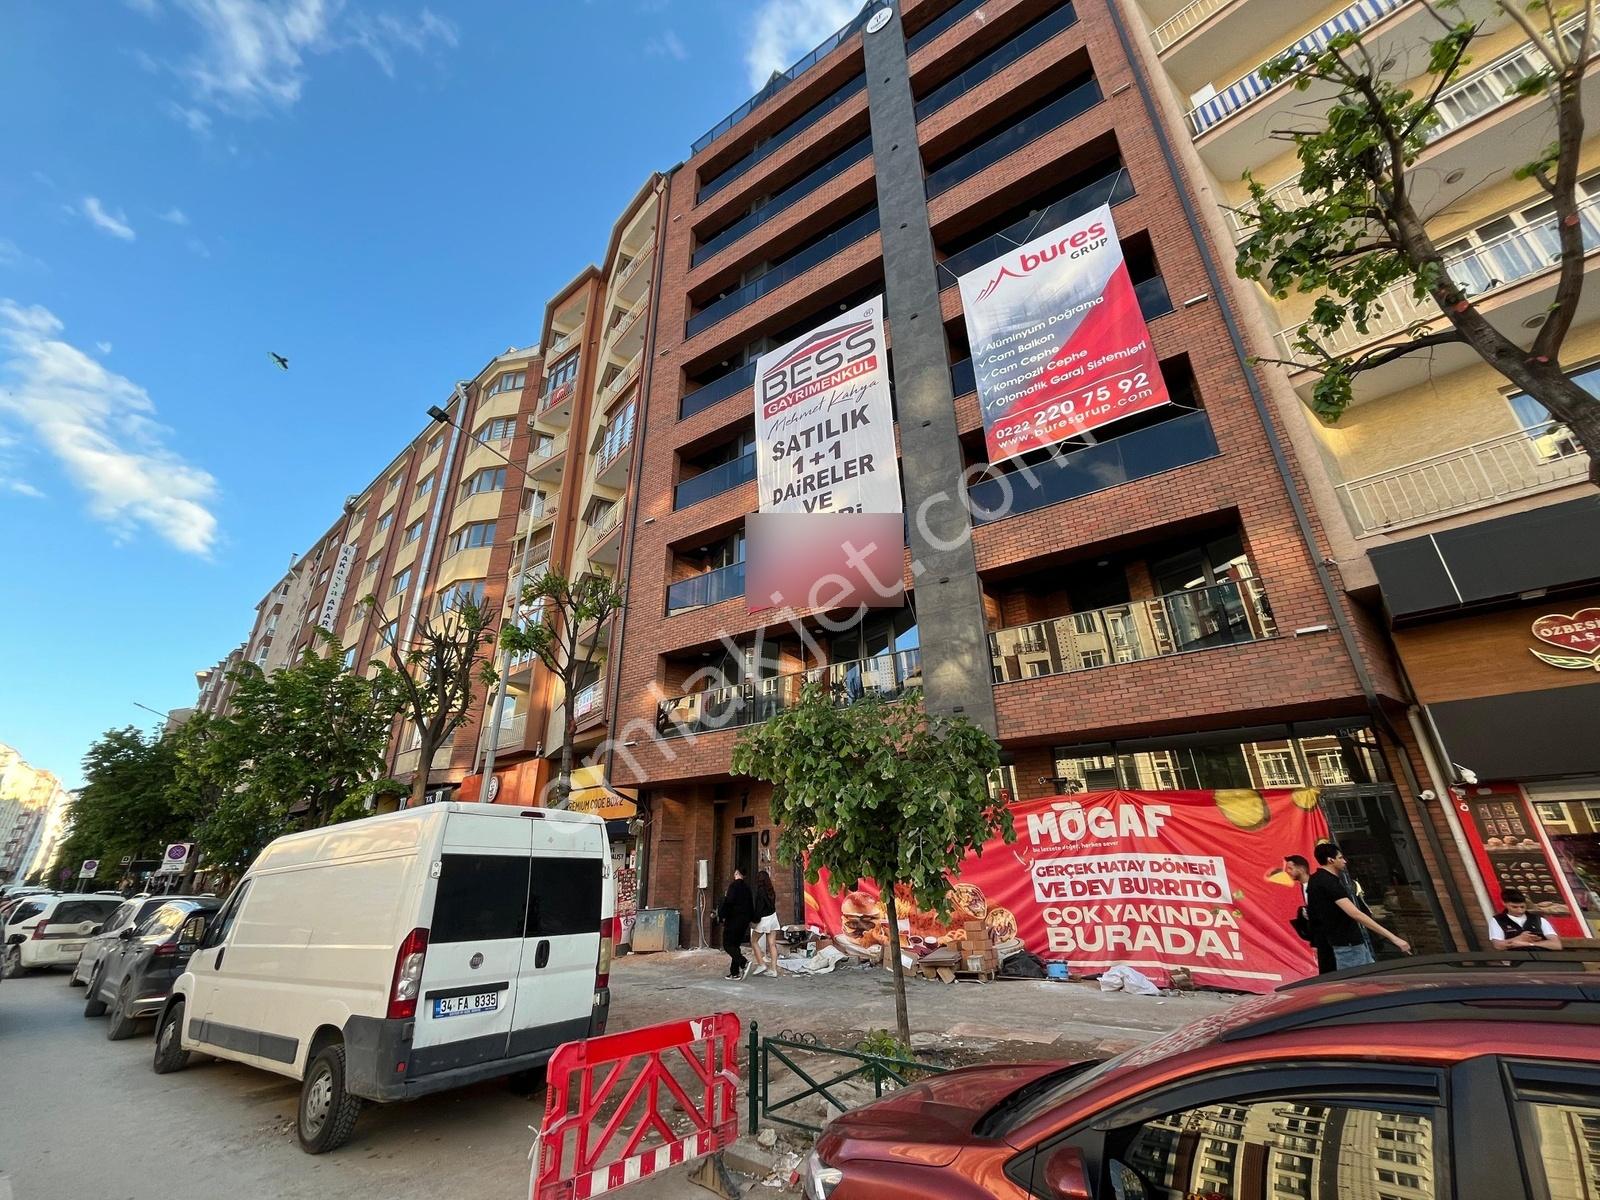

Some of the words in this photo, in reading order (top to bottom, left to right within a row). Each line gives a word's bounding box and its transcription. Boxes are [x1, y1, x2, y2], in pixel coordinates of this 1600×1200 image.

[1020, 222, 1105, 272] bures
[1070, 237, 1108, 260] GRUP
[1048, 296, 1104, 325] Doğrama
[988, 349, 1016, 363] Cam
[1018, 333, 1055, 353] Balkon
[991, 363, 1018, 378] Cam
[1020, 346, 1060, 367] Cephe
[762, 325, 876, 405] BESS
[993, 367, 1044, 393] Kompozit
[1047, 349, 1088, 371] Cephe
[996, 381, 1047, 406] Otomatik
[1050, 364, 1085, 385] Garaj
[1087, 340, 1147, 370] Sistemleri
[996, 421, 1030, 439] 0222
[1034, 400, 1075, 427] 220
[1082, 386, 1111, 407] 75
[1118, 372, 1150, 394] 92
[998, 388, 1153, 449] www.buresgrup.com
[772, 403, 871, 462] SATILIK
[802, 491, 833, 513] VE
[1036, 860, 1097, 879] GERÇEK
[1097, 859, 1146, 873] HATAY
[1150, 858, 1217, 876] DÖNERİ
[1038, 881, 1067, 898] VE
[1070, 878, 1115, 897] DEV
[1118, 877, 1222, 899] BURRITO
[1042, 905, 1103, 927] ÇOK
[1103, 904, 1240, 929] YAKINDA
[1046, 924, 1244, 960] BURADA!
[441, 999, 452, 1013] 34
[457, 997, 469, 1010] FA
[474, 993, 496, 1008] 8335
